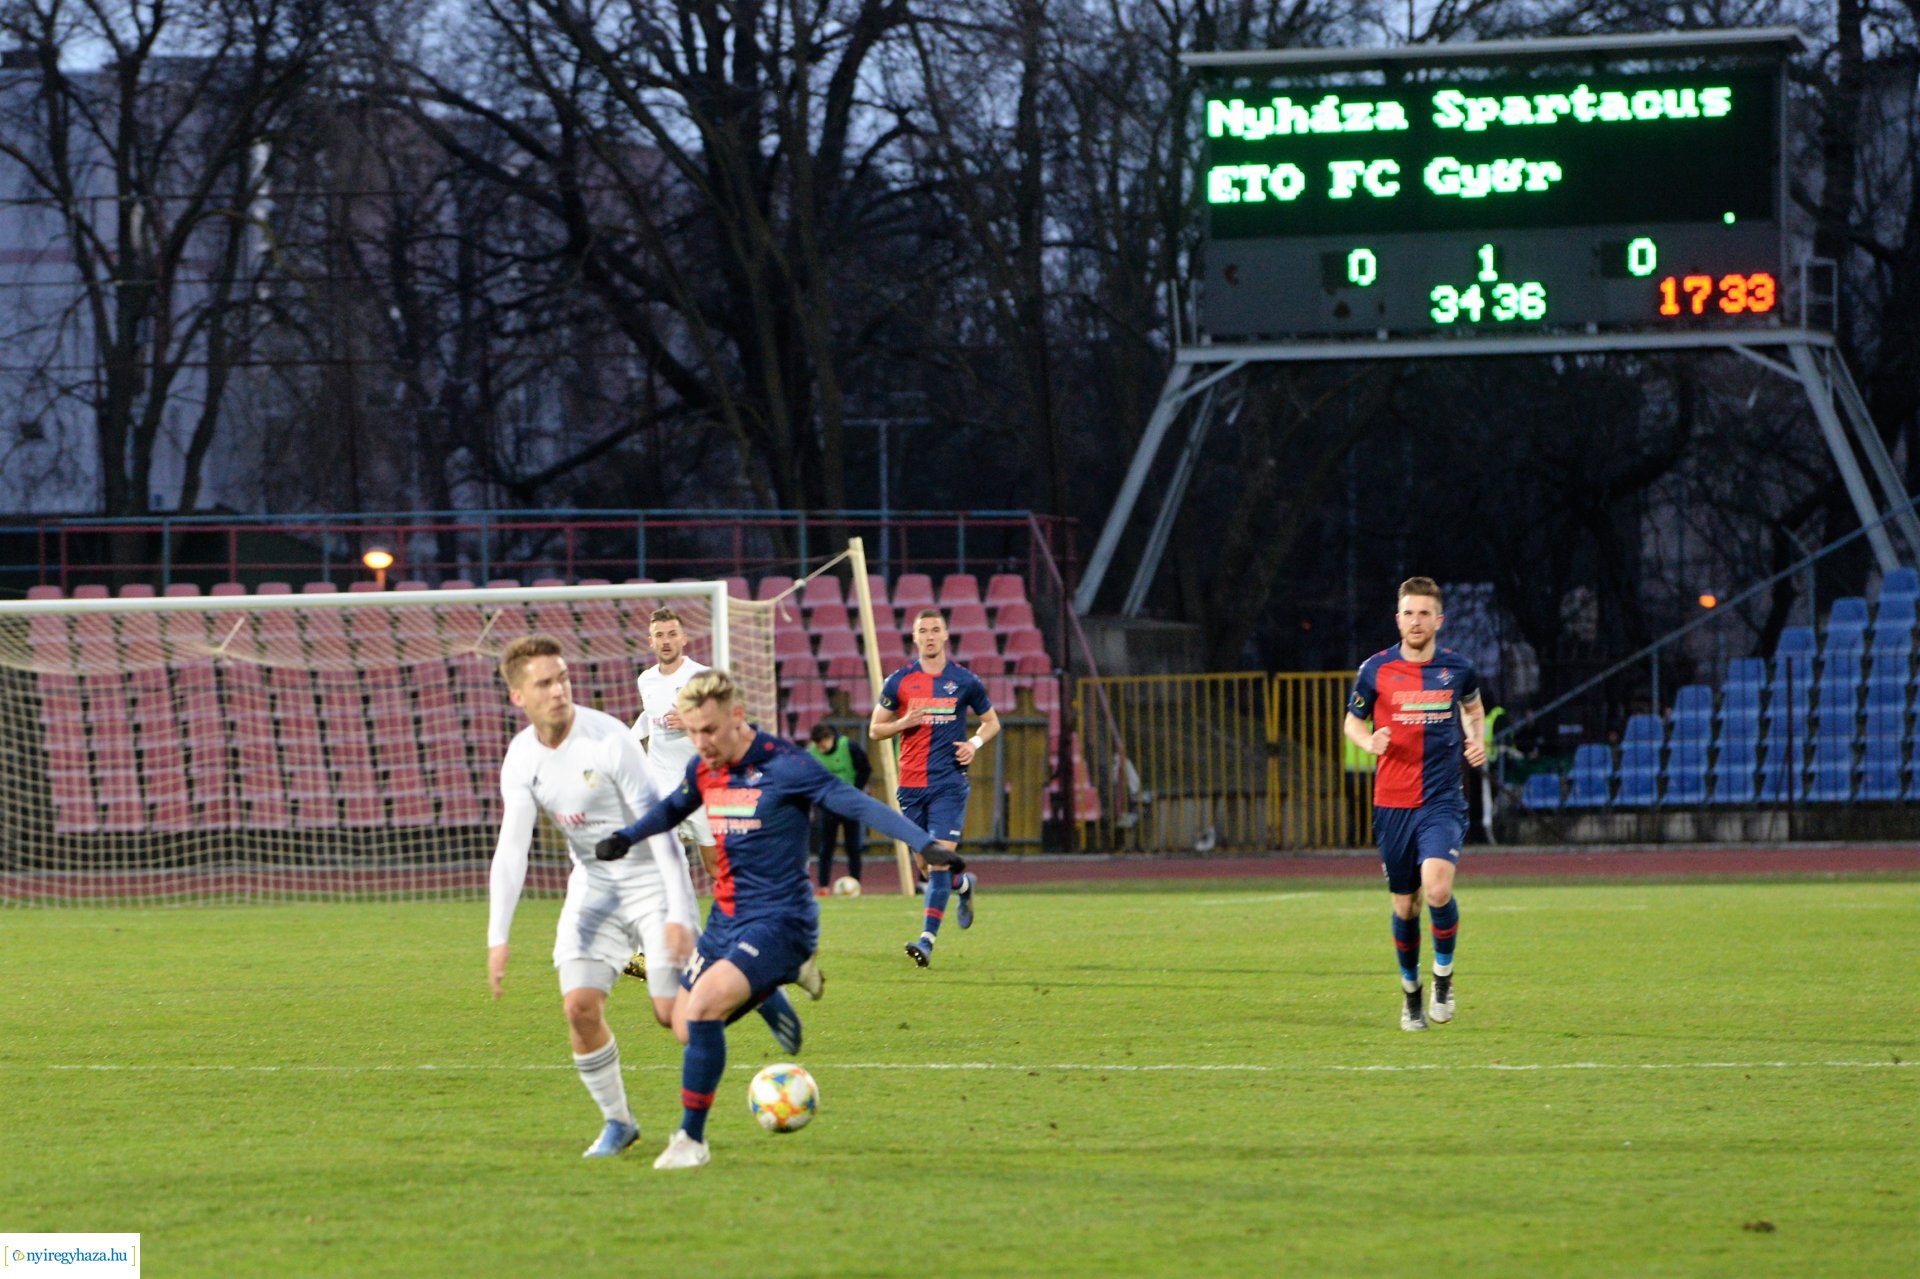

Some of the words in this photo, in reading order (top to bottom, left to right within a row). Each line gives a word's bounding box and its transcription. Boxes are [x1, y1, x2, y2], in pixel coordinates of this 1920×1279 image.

[1206, 94, 1409, 140] Nyháza
[1431, 83, 1732, 131] Spartacus
[1206, 162, 1306, 204] ETO
[1327, 158, 1401, 200] FC
[1347, 247, 1377, 287] 0
[1477, 243, 1499, 283] 1
[1627, 237, 1657, 277] 0
